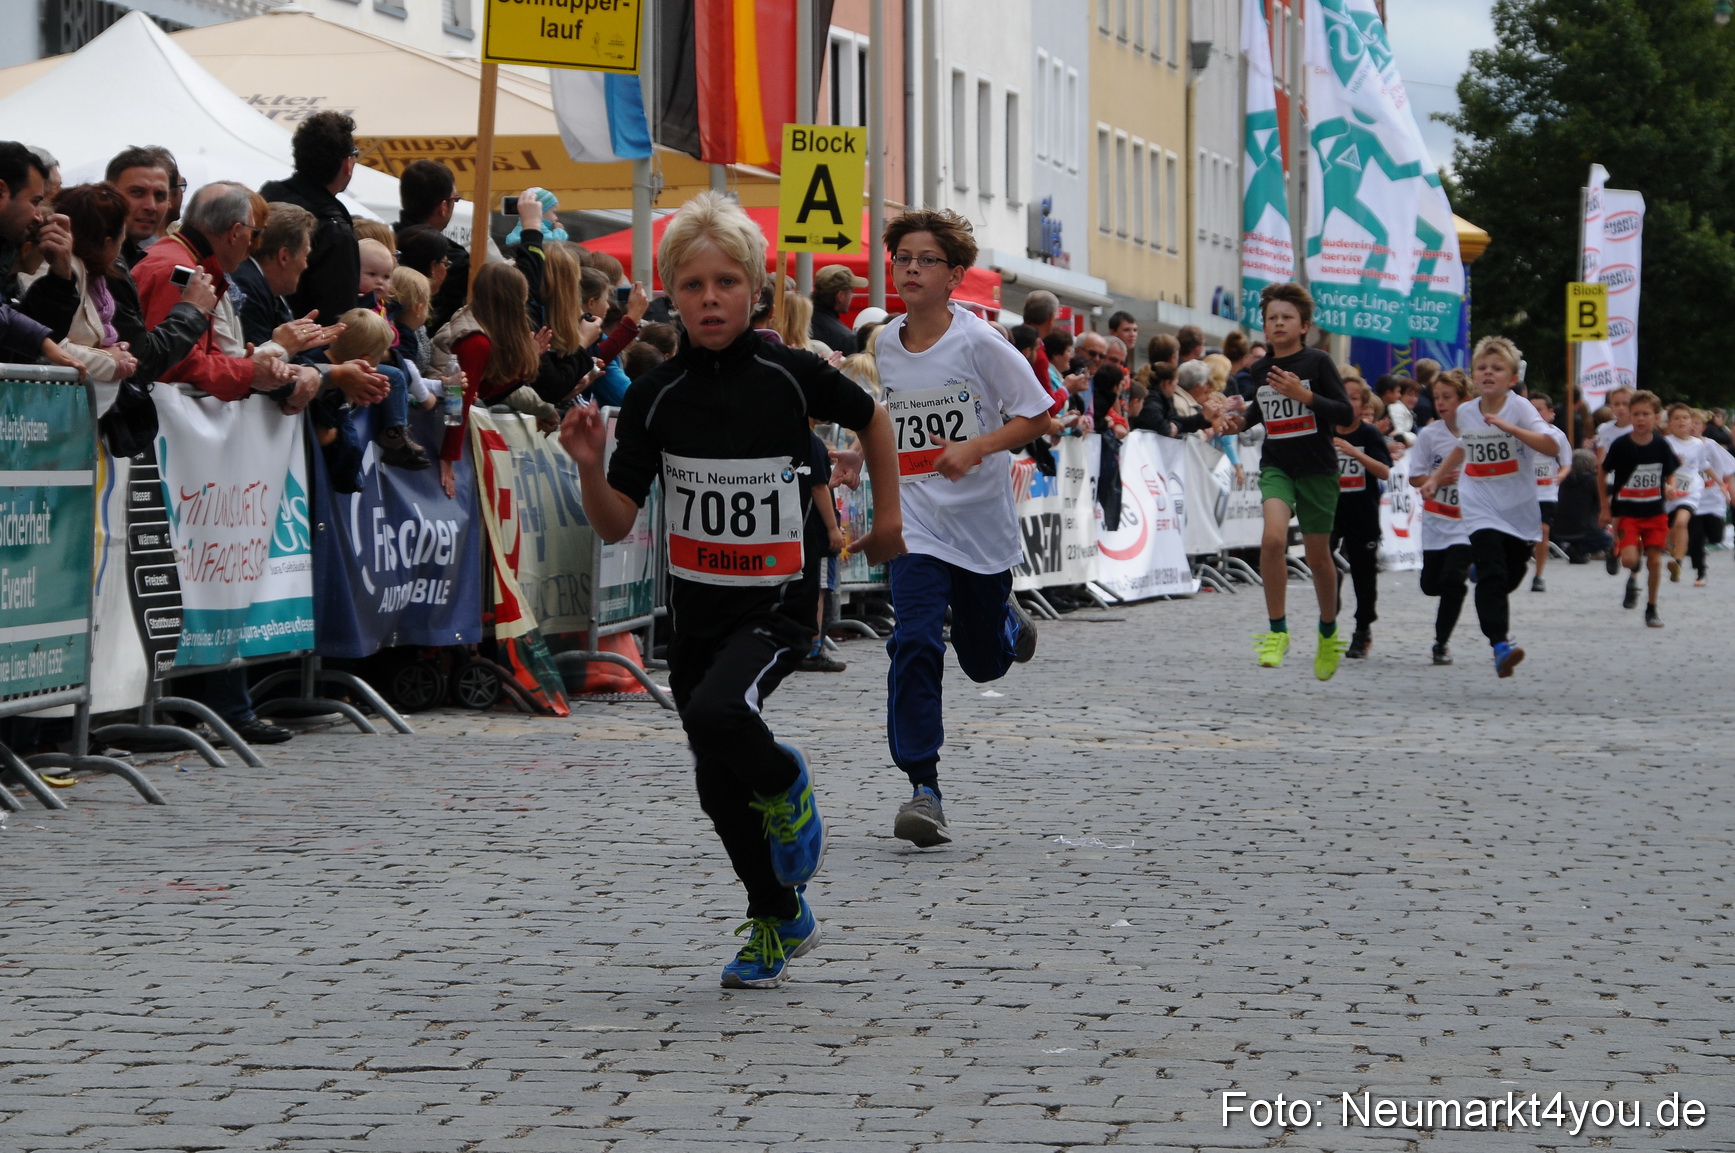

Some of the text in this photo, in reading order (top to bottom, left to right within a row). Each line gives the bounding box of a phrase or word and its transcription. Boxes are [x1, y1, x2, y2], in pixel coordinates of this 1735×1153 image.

[541, 17, 583, 39] lauf
[792, 129, 856, 153] Block
[795, 163, 844, 225] A
[1573, 285, 1604, 295] Block
[1353, 311, 1392, 333] 6352
[1409, 315, 1440, 331] 6352
[1579, 300, 1598, 328] B
[889, 395, 955, 411] PARTL Neumarkt
[895, 409, 968, 450] 7392
[1467, 441, 1510, 462] 7368
[666, 464, 776, 485] PARTL Neumarkt
[675, 485, 780, 538] 7081
[137, 534, 160, 546] Wärme
[372, 502, 460, 573] Fischer
[790, 529, 799, 540] M
[697, 546, 764, 571] Fabian
[1, 566, 36, 610] Event!
[143, 574, 169, 587] Freizeit
[149, 616, 181, 630] Stadtbusse
